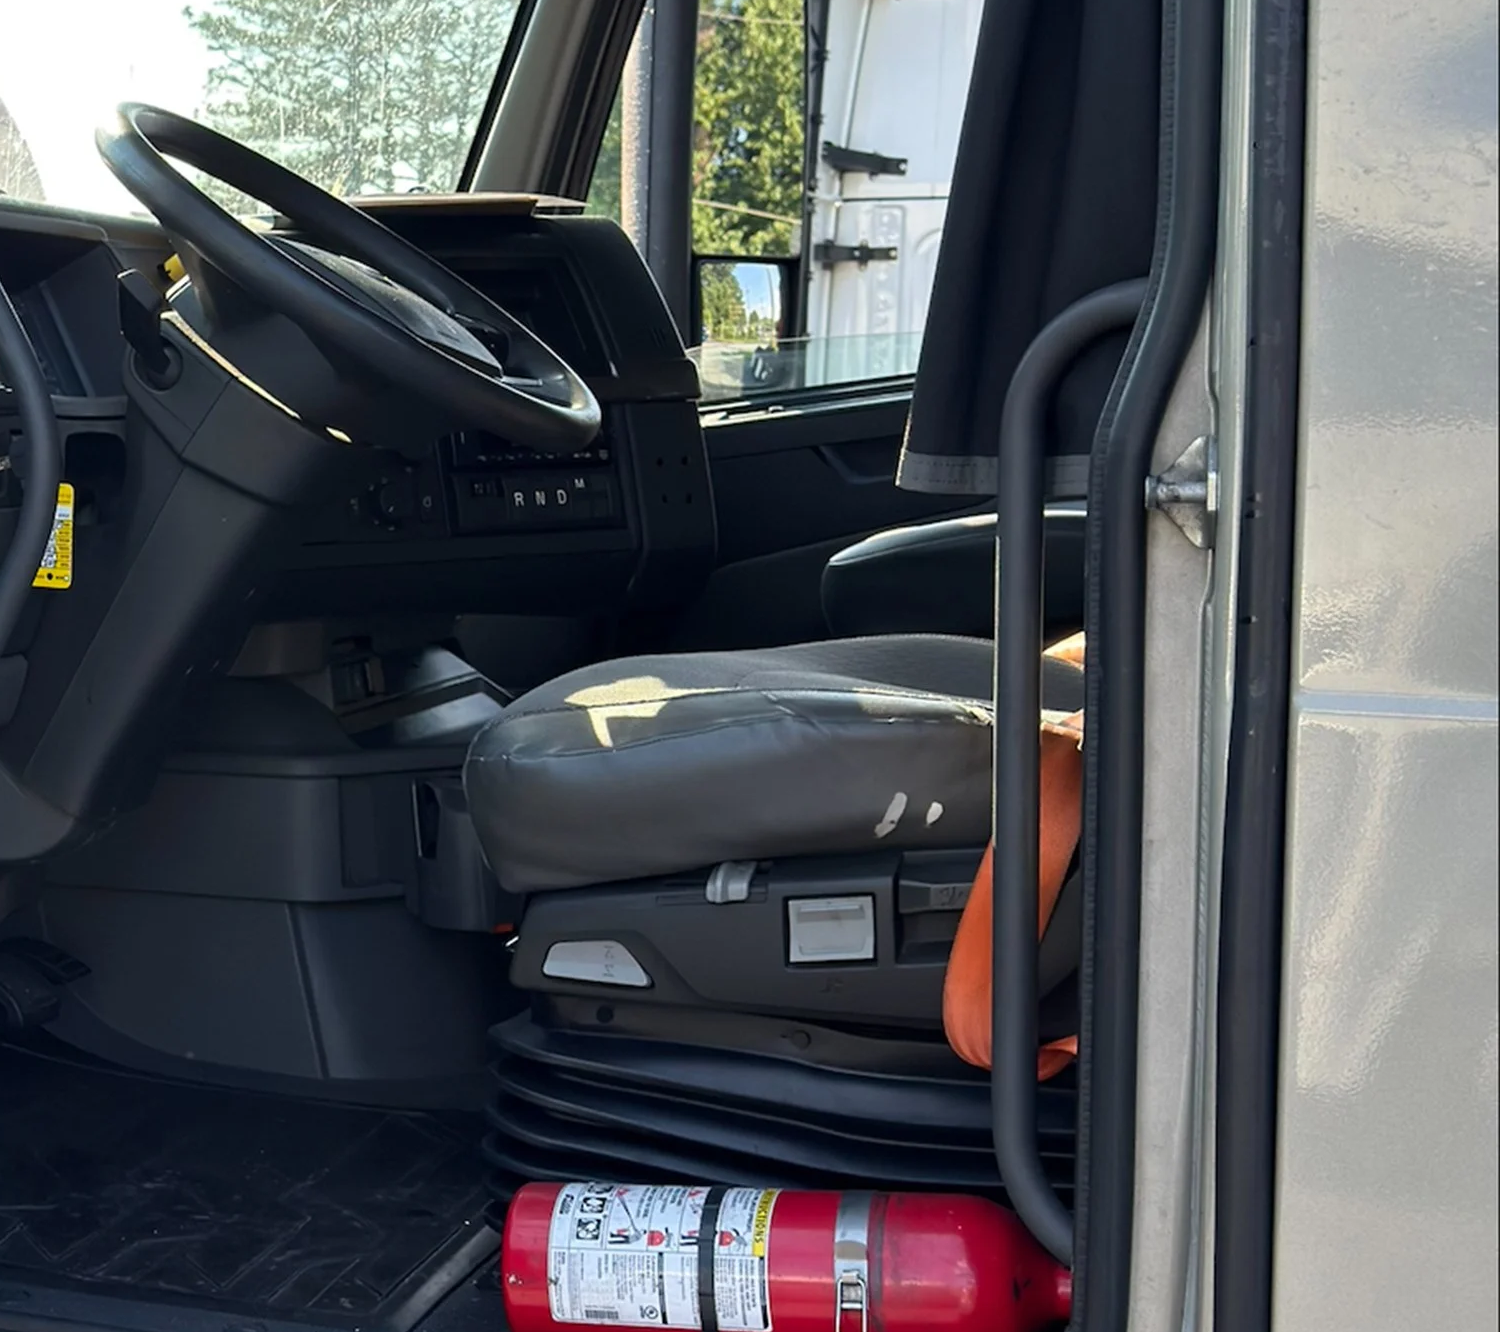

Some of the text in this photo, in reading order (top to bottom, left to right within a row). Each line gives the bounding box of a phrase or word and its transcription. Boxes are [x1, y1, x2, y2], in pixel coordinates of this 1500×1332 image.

[574, 478, 585, 489] M
[513, 490, 567, 507] R N D
